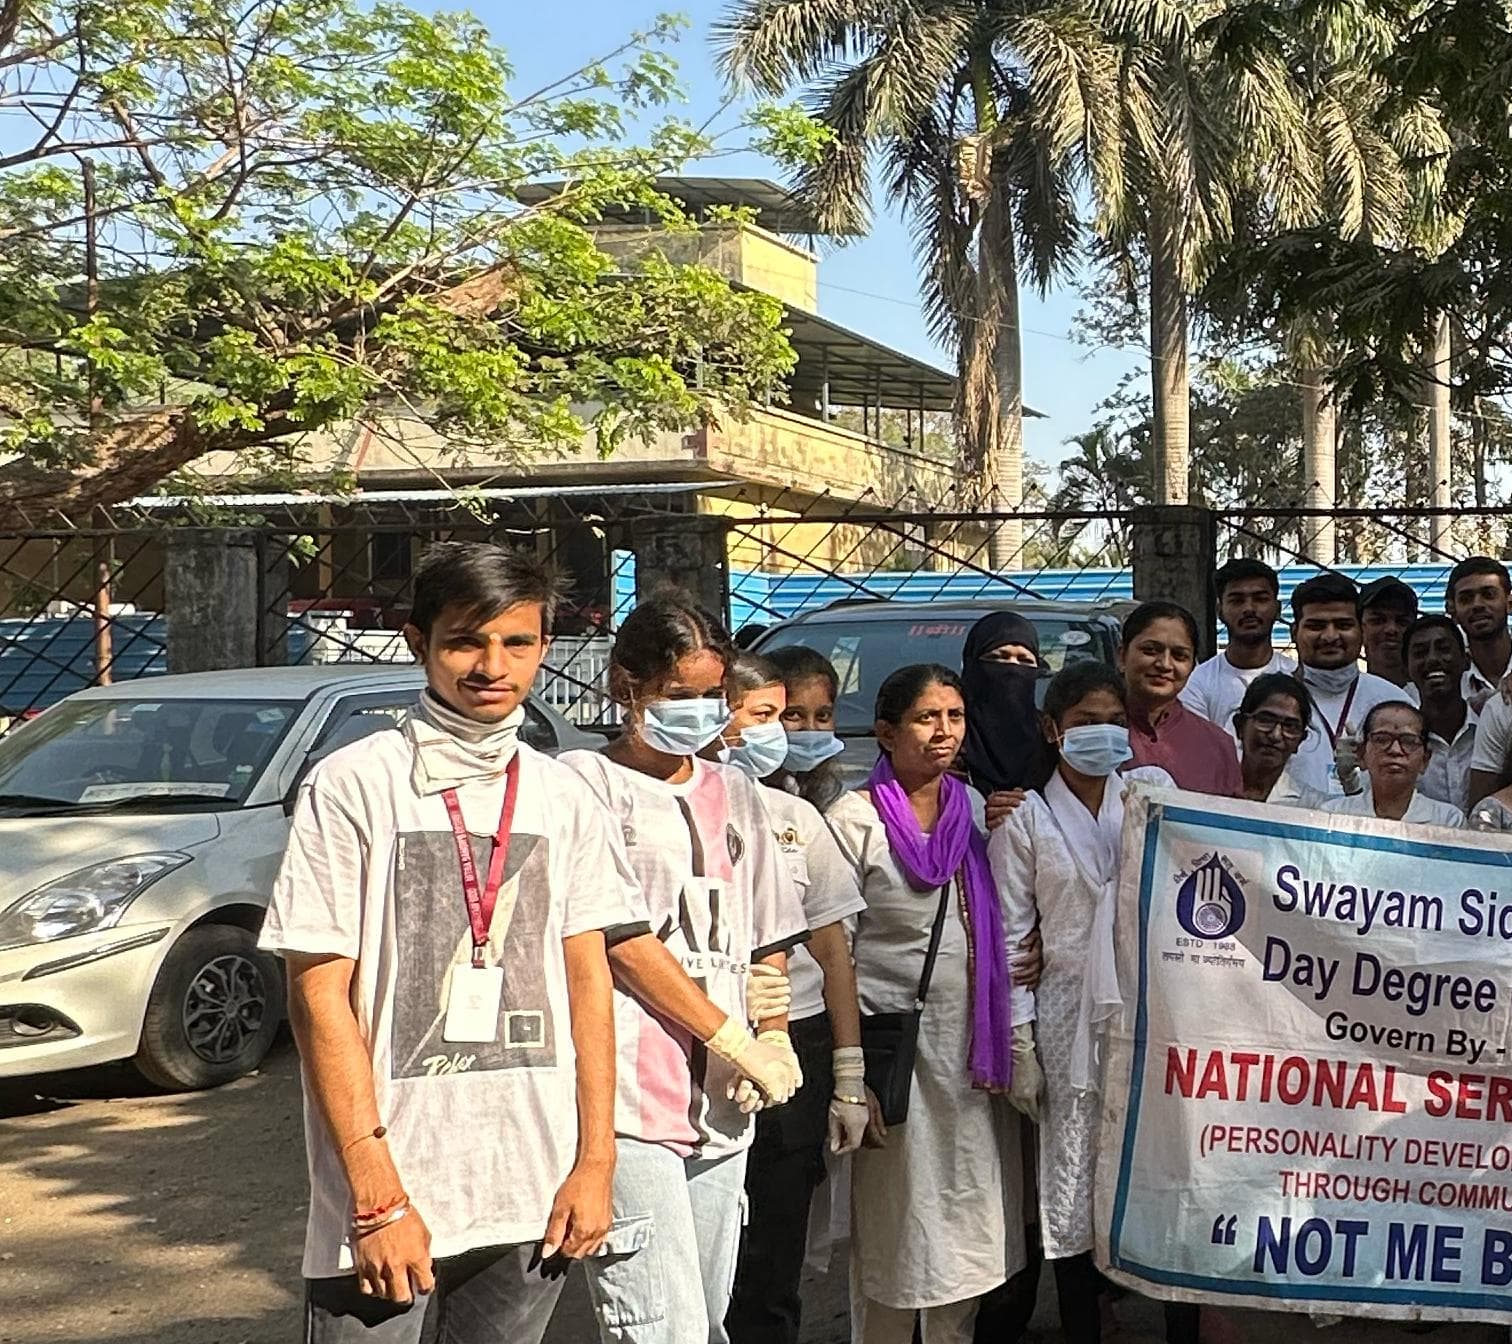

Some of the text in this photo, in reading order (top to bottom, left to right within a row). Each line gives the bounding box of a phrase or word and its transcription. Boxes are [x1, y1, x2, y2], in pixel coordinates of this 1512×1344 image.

[1273, 864, 1443, 935] Swayam
[1175, 937, 1204, 949] ESTD
[1262, 936, 1340, 1000] Day
[1352, 952, 1497, 1016] Degree
[1325, 1011, 1435, 1054] Govern
[1445, 1029, 1487, 1064] By
[1164, 1046, 1408, 1113] NATIONAL
[1200, 1123, 1399, 1163] (PERSONALITY
[1278, 1170, 1411, 1204] THROUGH
[1253, 1215, 1370, 1278] NOT
[1384, 1221, 1464, 1283] ME
